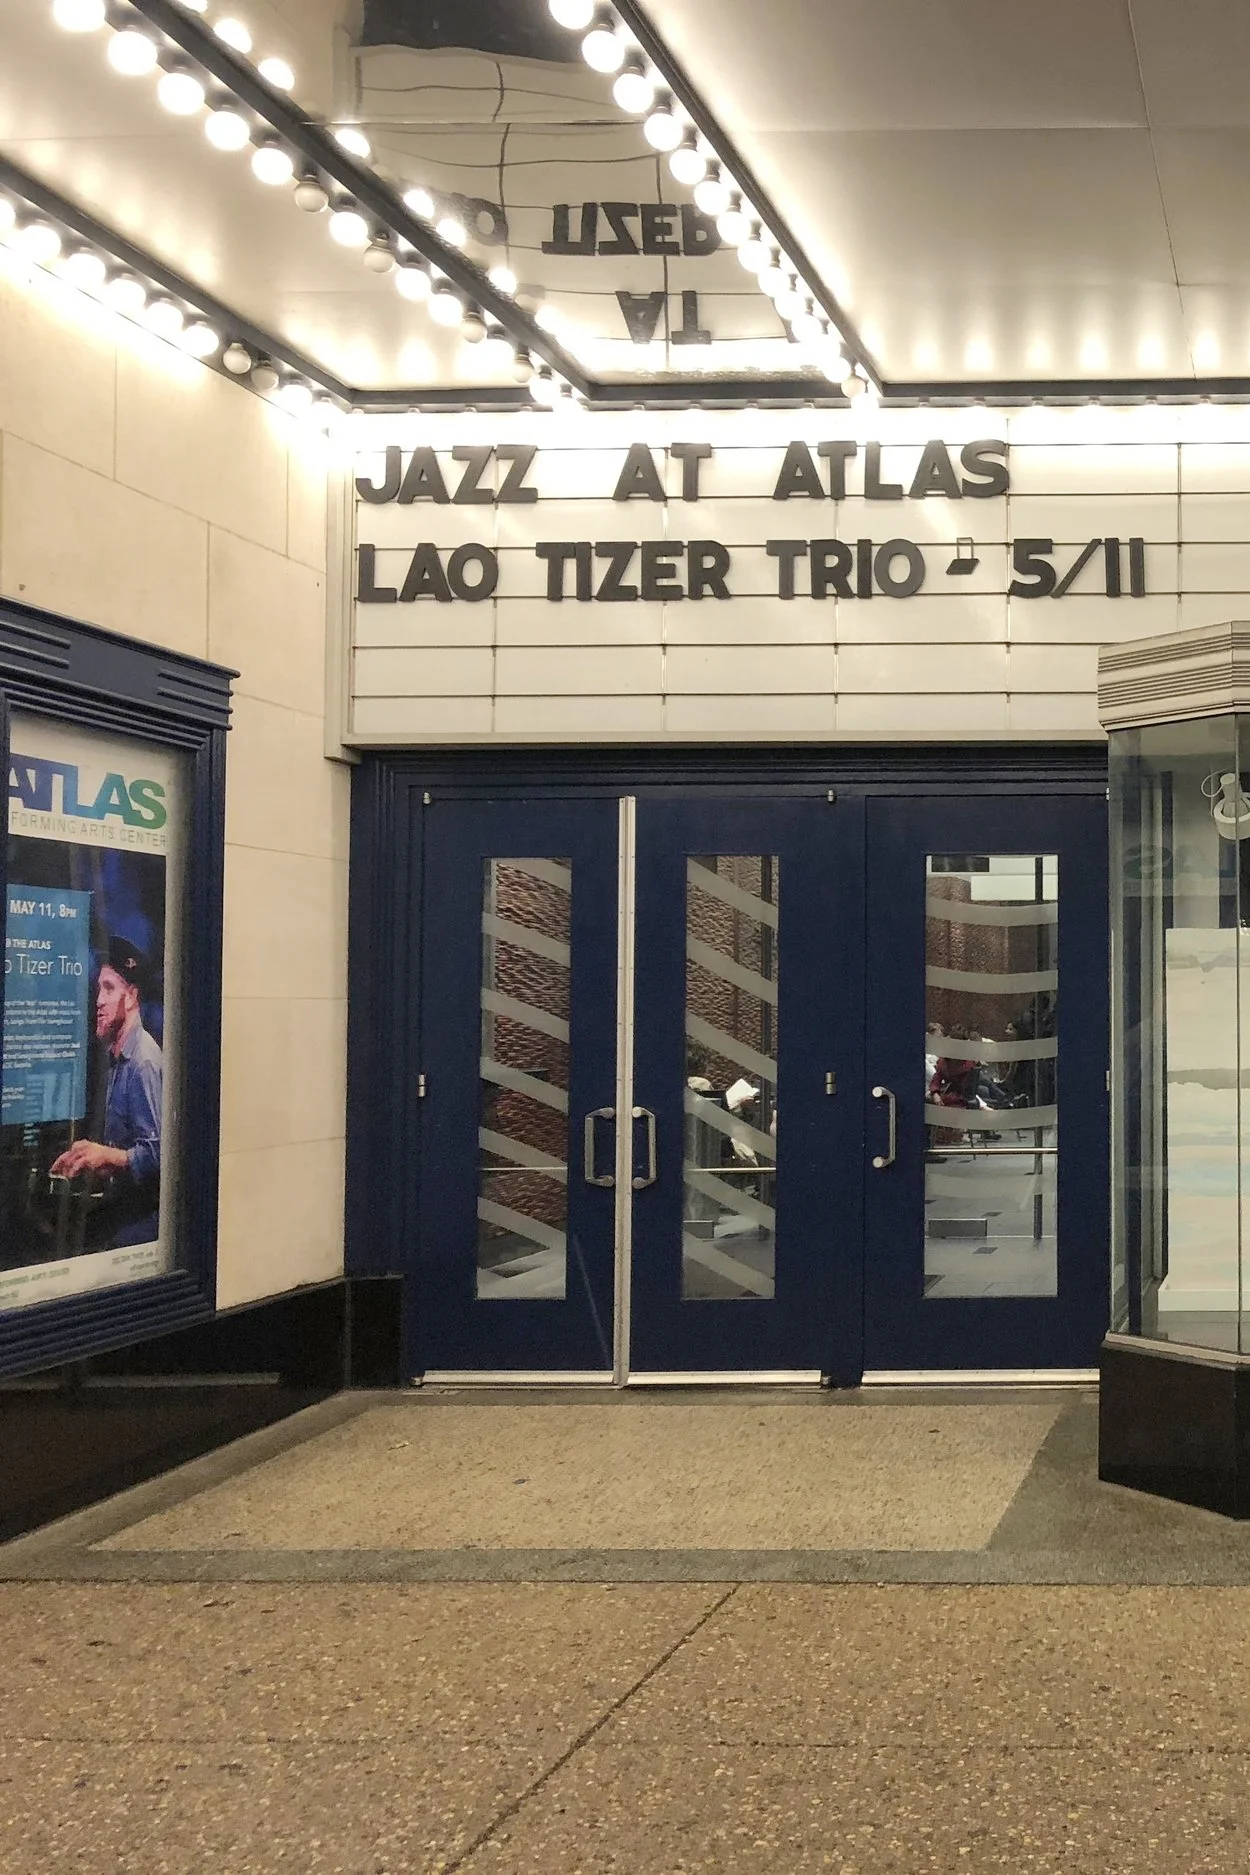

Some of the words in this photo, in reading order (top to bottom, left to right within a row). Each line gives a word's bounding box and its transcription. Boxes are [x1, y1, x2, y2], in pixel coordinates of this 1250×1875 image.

[355, 444, 539, 504] JAZZ
[613, 443, 712, 501] AT
[773, 439, 1010, 499] ATLAS
[358, 543, 499, 602] LAO
[535, 540, 731, 602] TIZER
[766, 538, 926, 600] TRIO
[1008, 537, 1146, 599] 5/11
[9, 752, 167, 830] ATLAS
[80, 821, 115, 840] ARTS
[118, 828, 168, 847] CENTER
[10, 899, 36, 915] MAY
[39, 902, 55, 919] 11,
[12, 938, 27, 948] THE
[28, 940, 52, 950] ATLAS
[16, 953, 54, 975] Tizer
[58, 955, 83, 976] Trio
